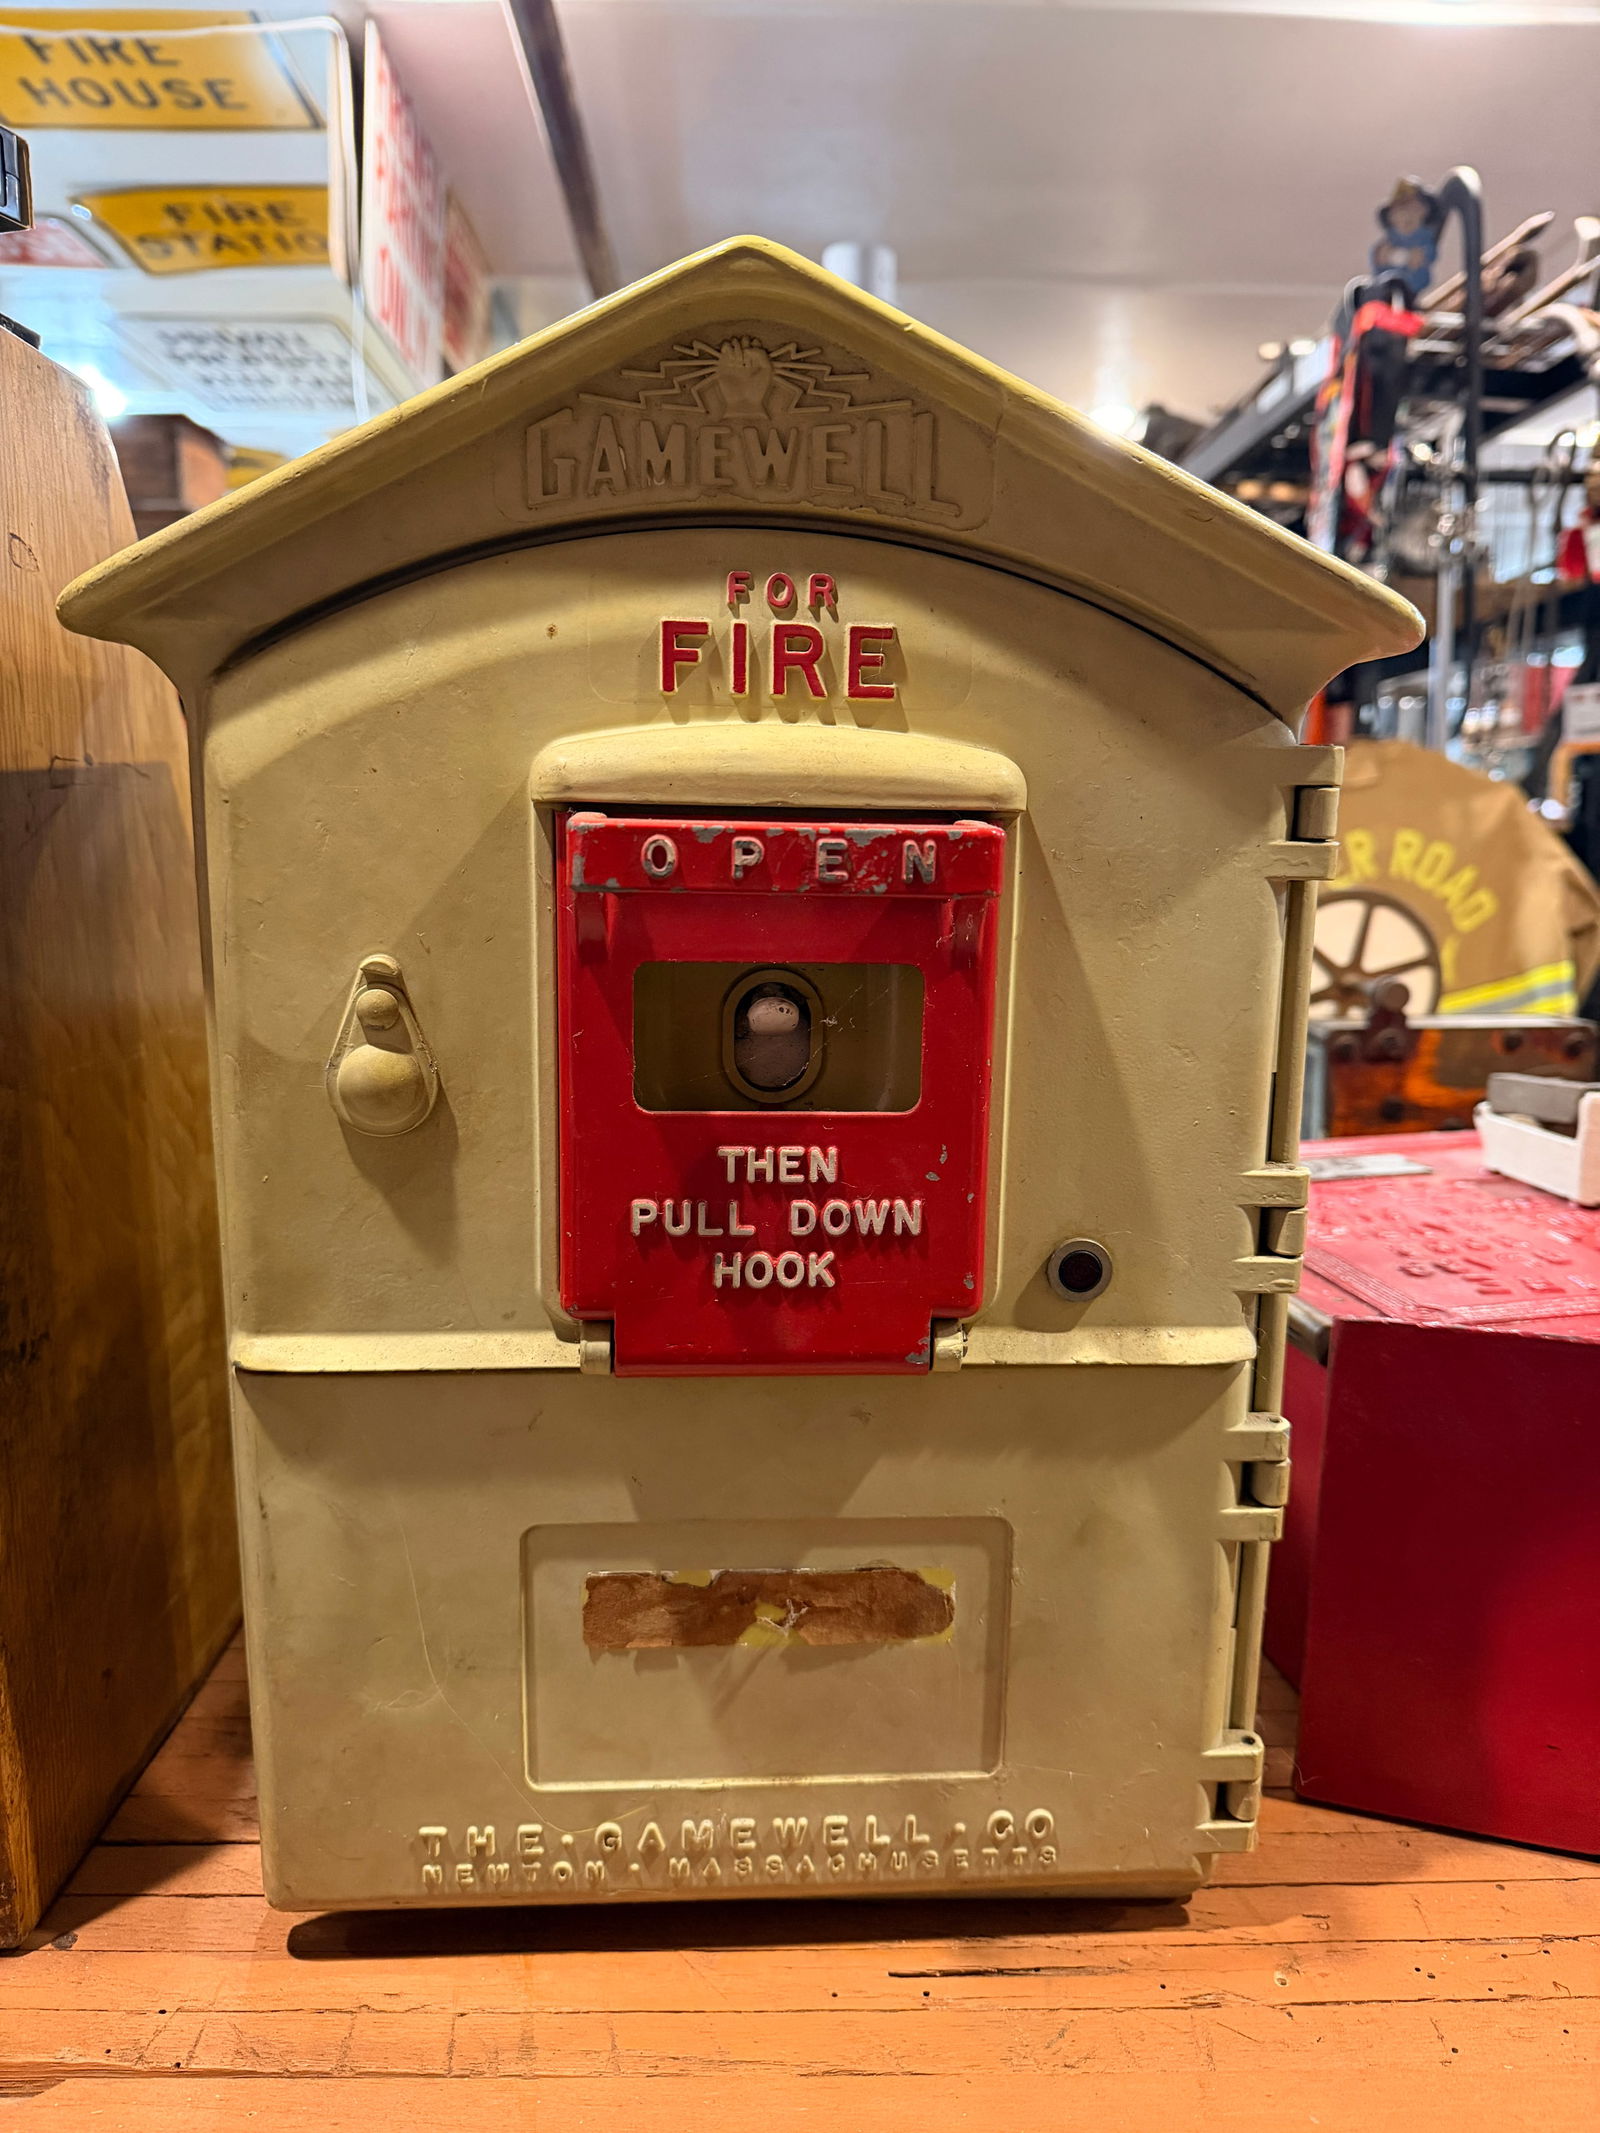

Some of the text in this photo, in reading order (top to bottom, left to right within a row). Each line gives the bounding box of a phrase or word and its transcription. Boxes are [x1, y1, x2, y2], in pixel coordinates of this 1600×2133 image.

[21, 32, 180, 66] FIRE
[18, 76, 248, 110] HOUSE
[162, 202, 309, 226] FIRE
[526, 408, 961, 517] GAMEWELL
[726, 570, 838, 608] FOR
[659, 617, 898, 700] FIRE
[641, 834, 937, 884] OPEN
[1390, 828, 1496, 932] ROAD
[717, 1145, 839, 1184] THEN
[630, 1199, 923, 1237] PULL DOWN
[712, 1250, 836, 1289] HOOK
[418, 1808, 1054, 1857] THE GAMEWELL CO
[422, 1845, 1056, 1884] NEWTON MASSACHUSETTS
